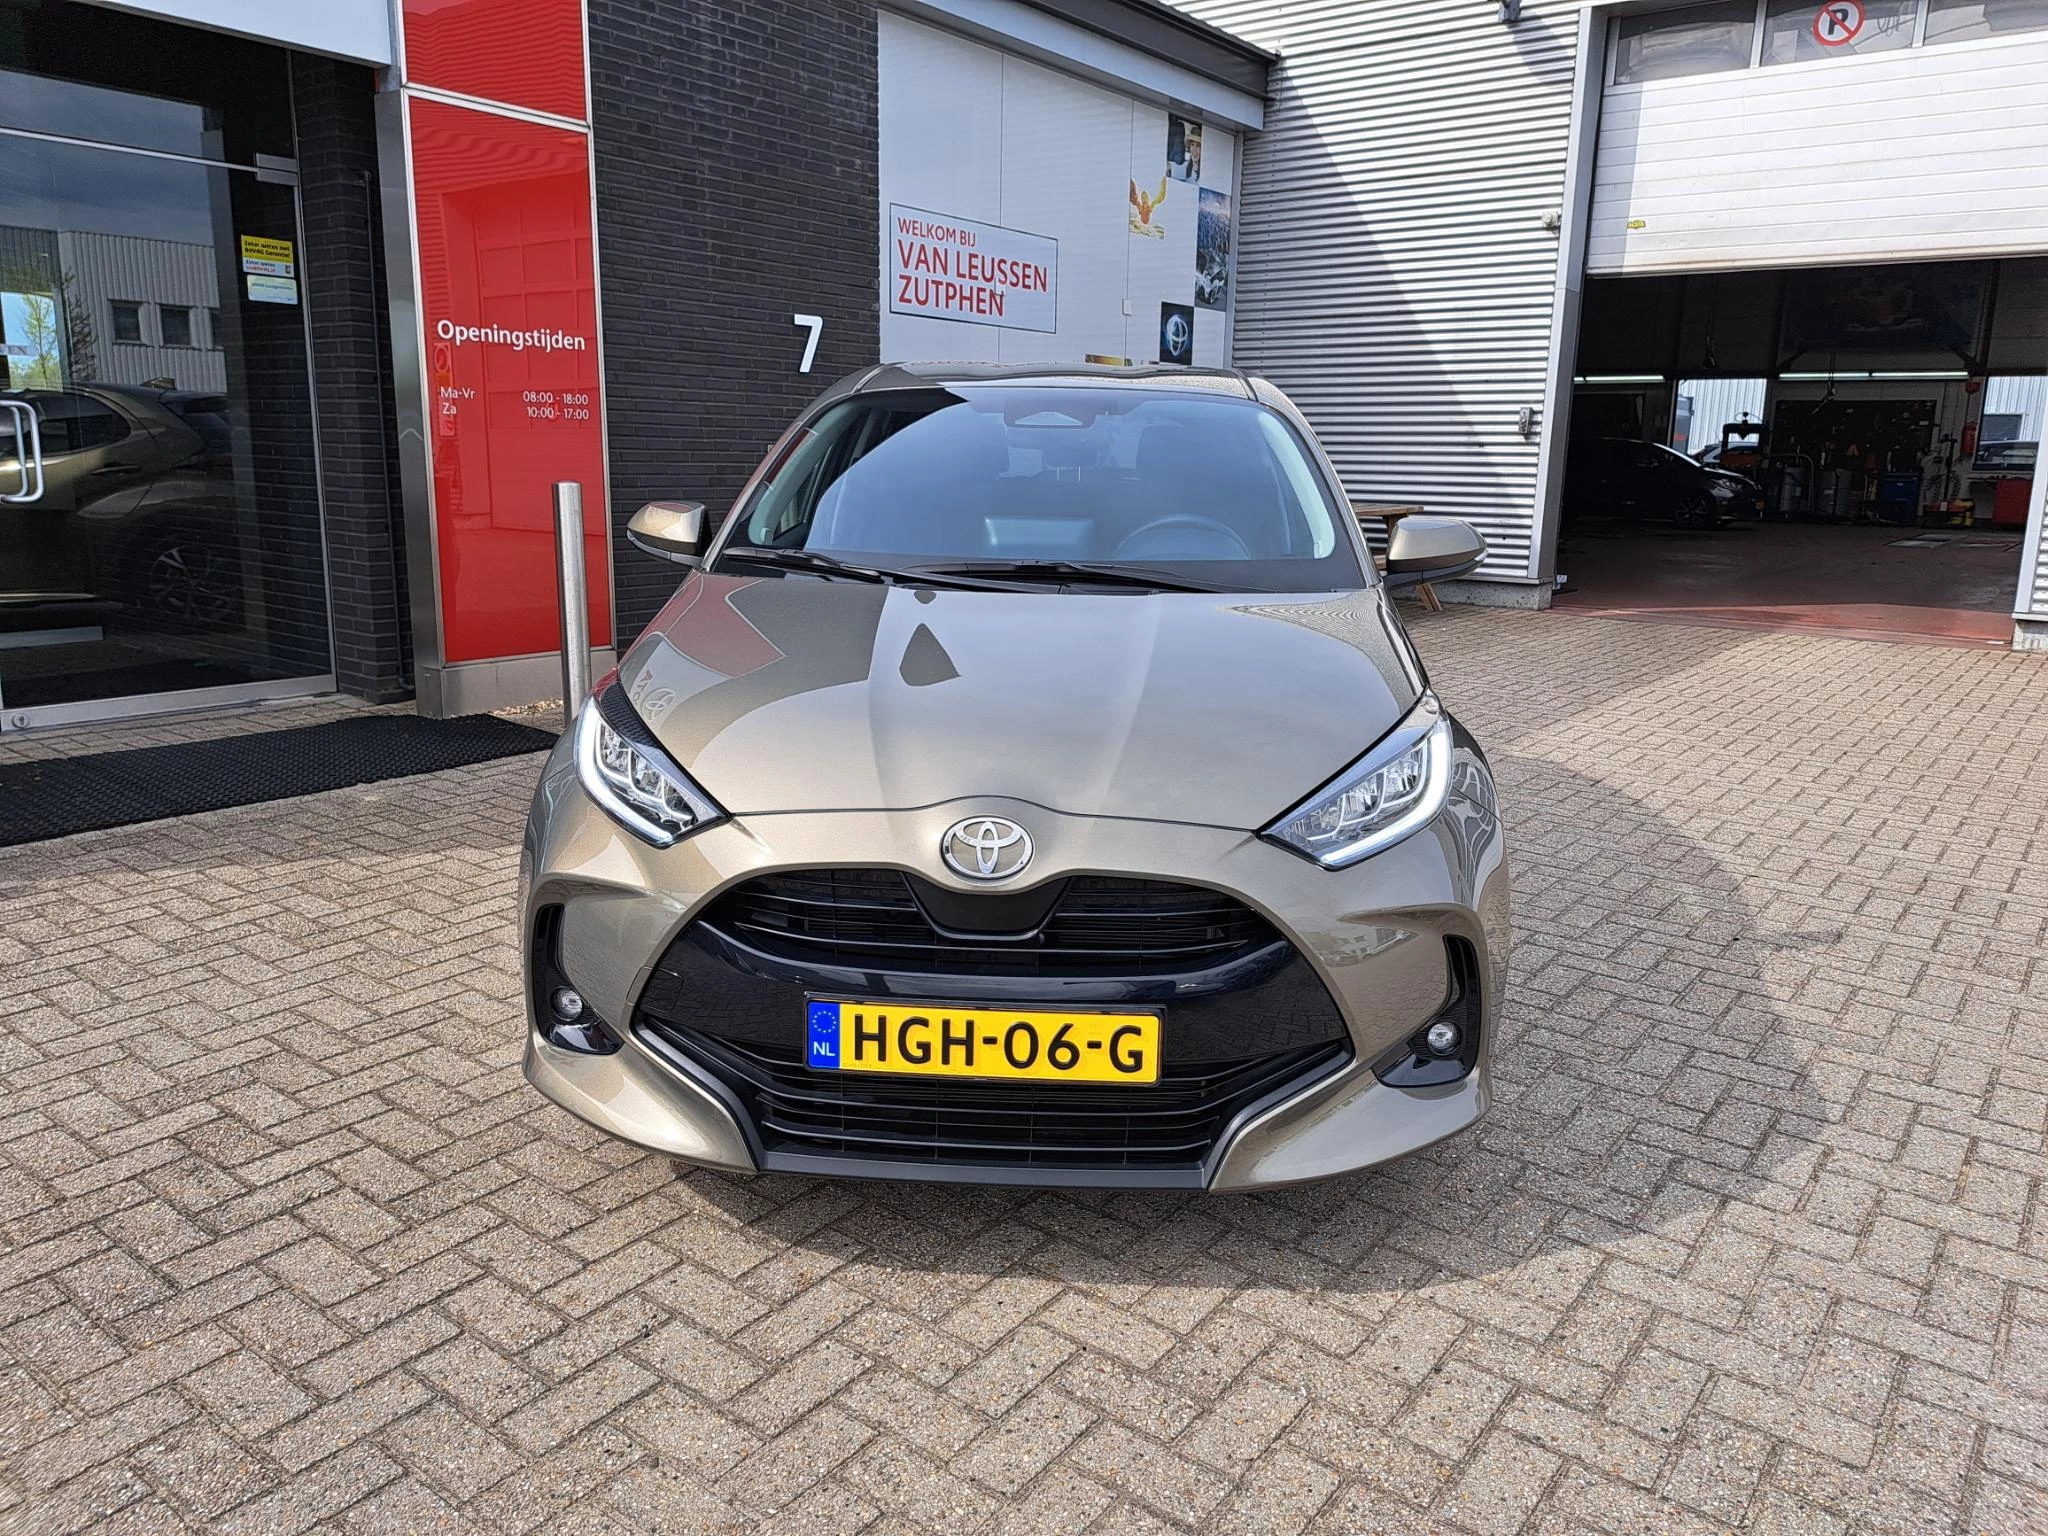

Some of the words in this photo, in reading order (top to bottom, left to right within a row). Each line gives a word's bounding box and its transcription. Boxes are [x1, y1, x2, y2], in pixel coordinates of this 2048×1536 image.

[897, 217, 956, 243] WELKOM
[959, 230, 976, 247] BIJ
[897, 239, 949, 276] VAN
[956, 250, 1047, 293] LEUSSEN
[898, 274, 1004, 317] ZUTPHEN
[437, 319, 585, 352] Openingstijden
[794, 313, 823, 373] 7
[440, 386, 475, 399] Ma-Vr
[523, 390, 553, 403] 08:00
[562, 392, 589, 405] 18:00
[442, 402, 457, 415] Za
[527, 406, 555, 418] 10:00
[563, 408, 590, 420] 17:00
[813, 1042, 836, 1056] NL
[853, 1013, 1144, 1073] HGH-06-G
